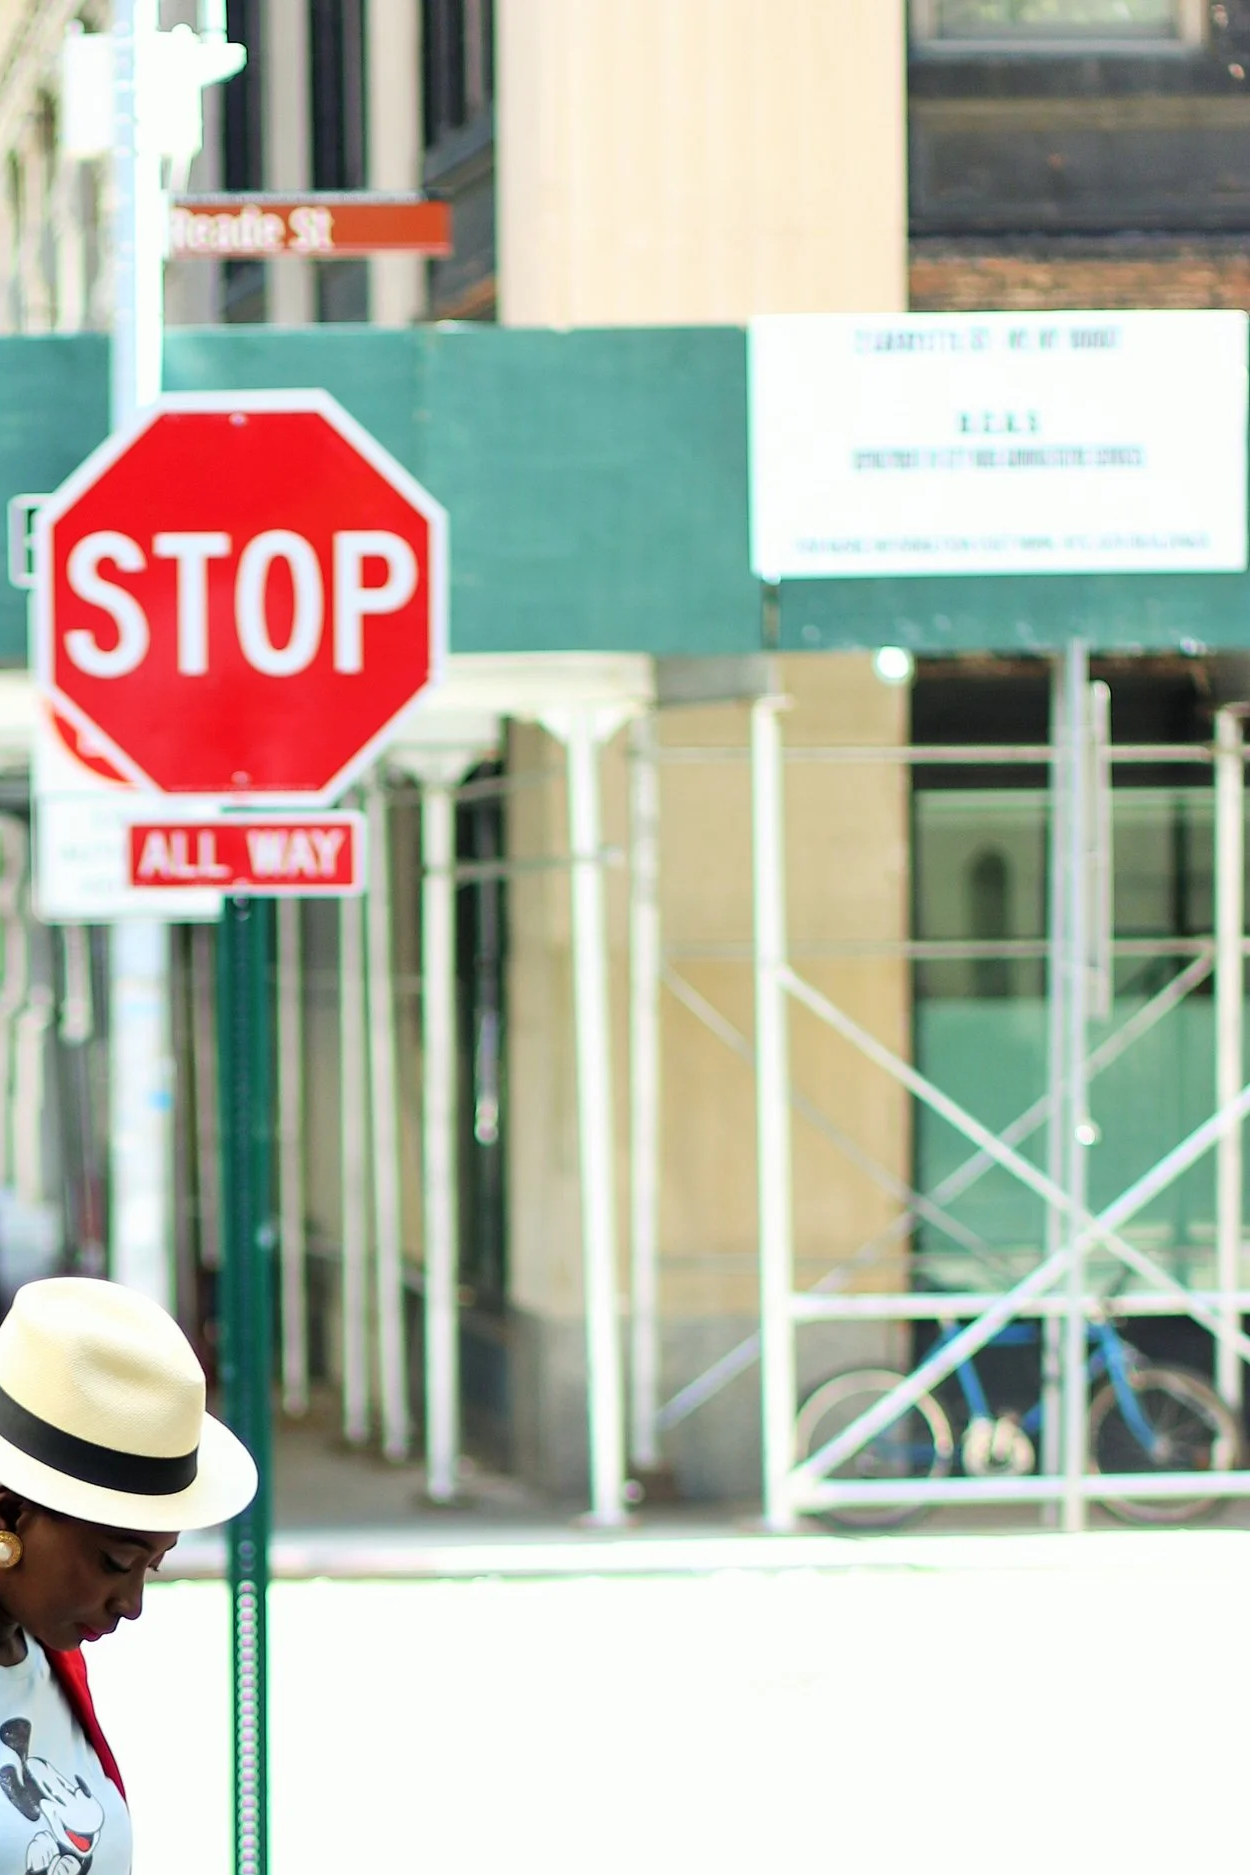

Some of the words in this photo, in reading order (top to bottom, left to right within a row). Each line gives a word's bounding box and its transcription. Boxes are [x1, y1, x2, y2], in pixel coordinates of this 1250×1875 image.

[288, 206, 334, 251] St
[64, 529, 419, 679] STOP
[137, 829, 232, 879] ALL
[246, 827, 345, 878] WAY
